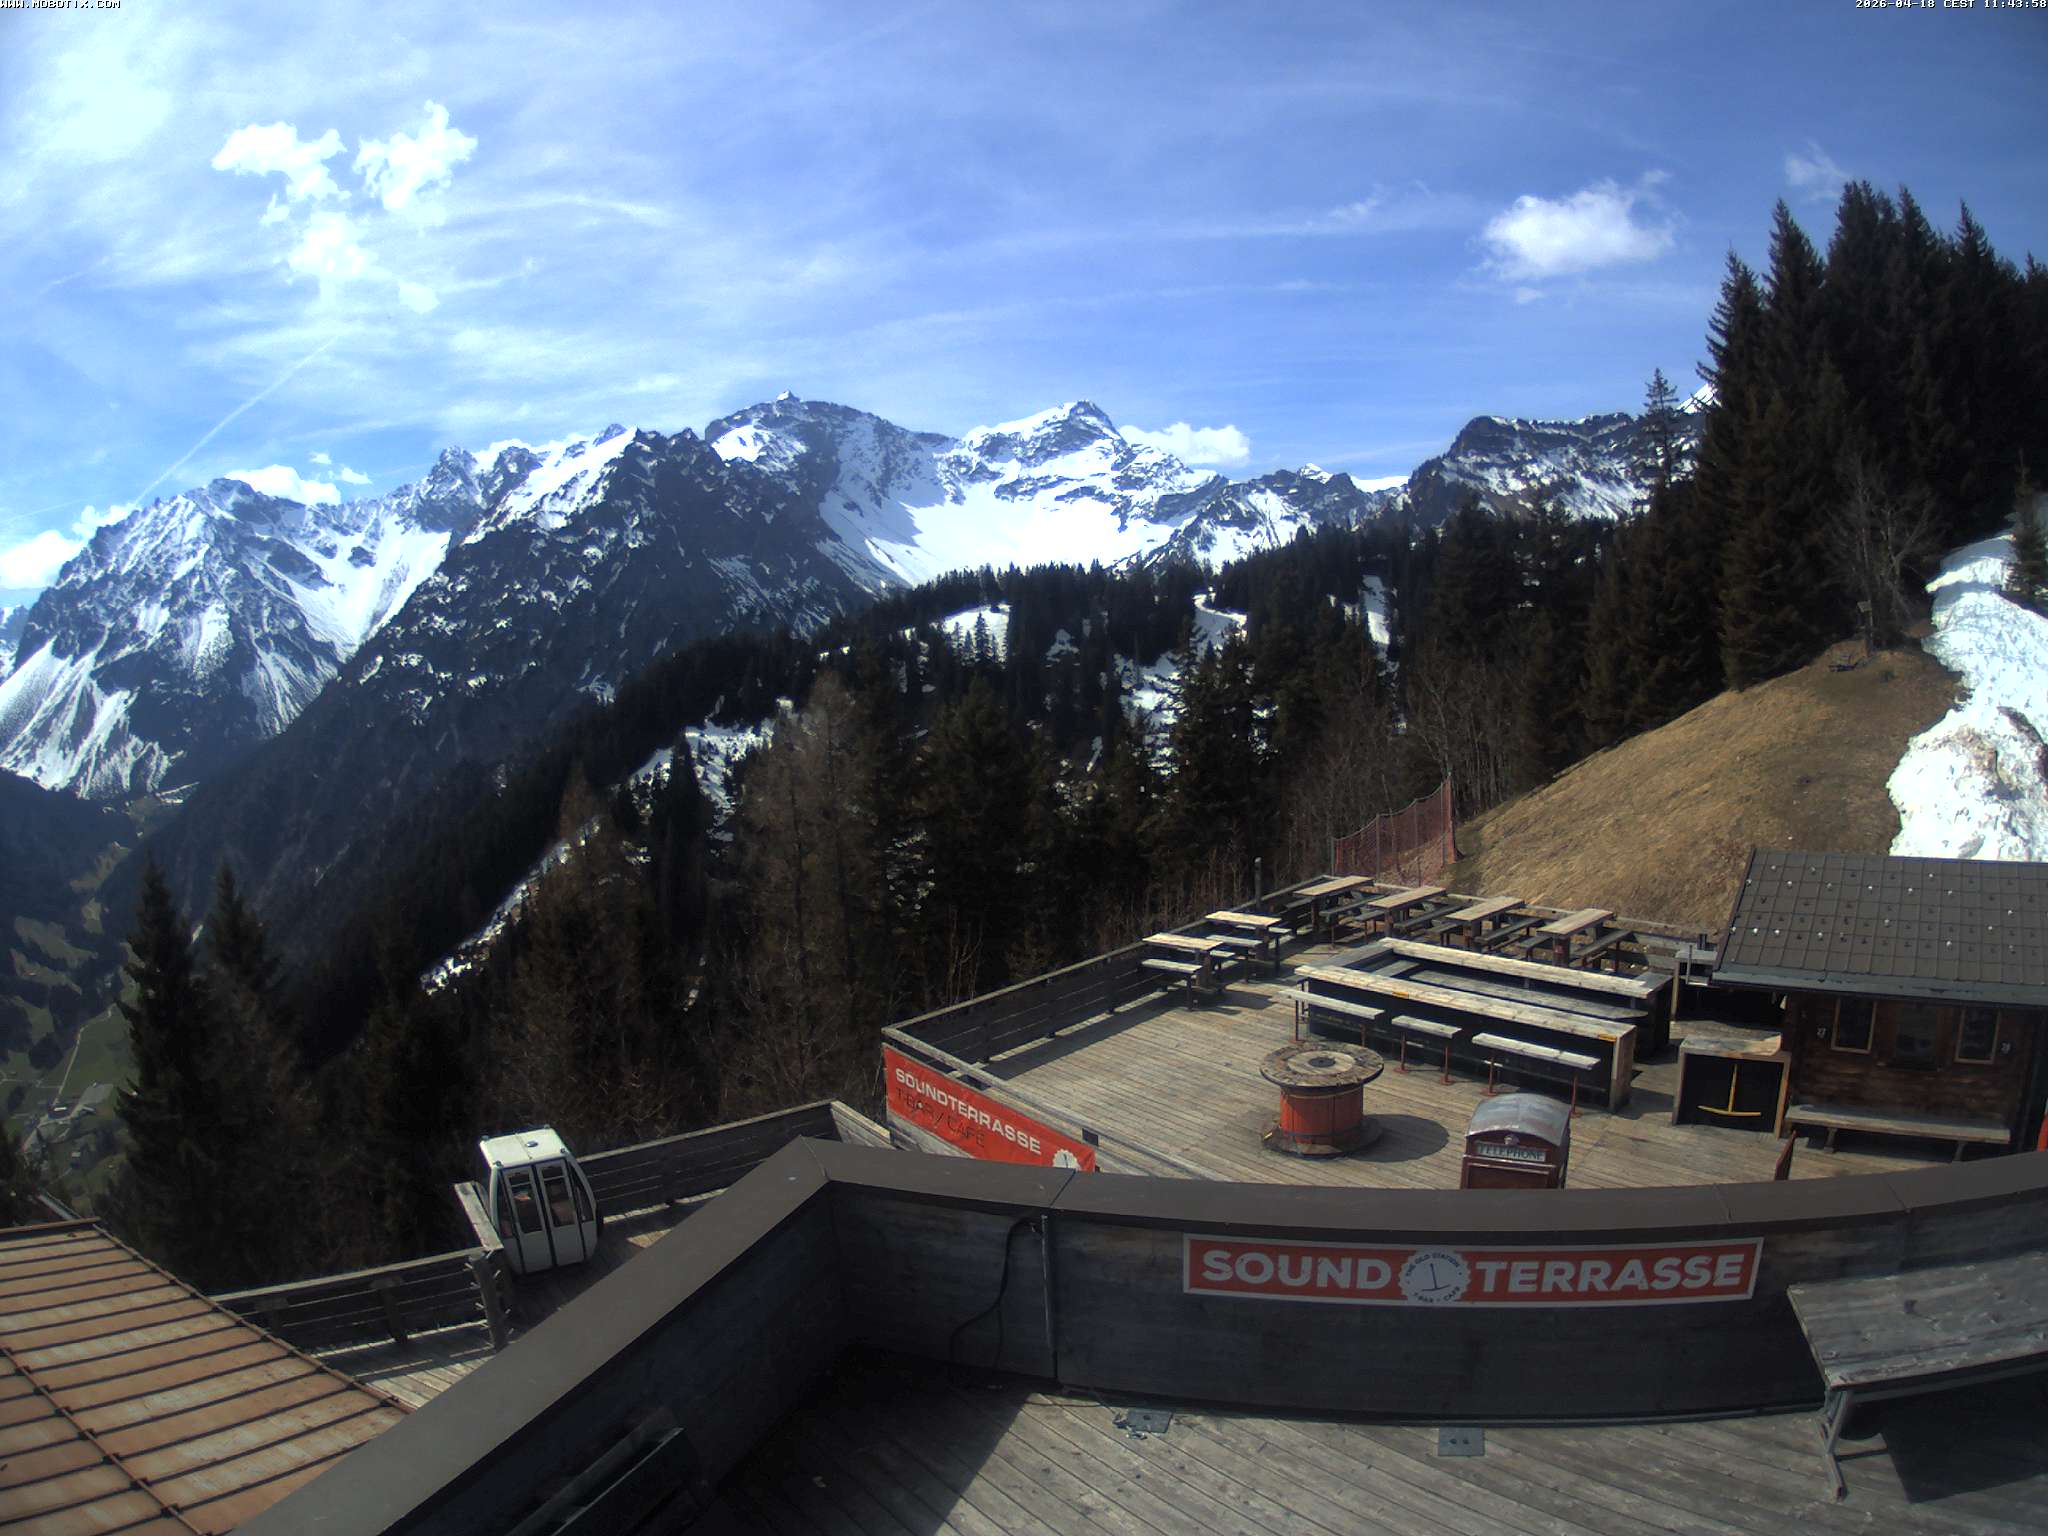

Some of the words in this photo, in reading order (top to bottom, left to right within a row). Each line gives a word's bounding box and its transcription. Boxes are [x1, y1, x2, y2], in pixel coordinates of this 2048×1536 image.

[895, 1067, 1042, 1156] SOUNDTERRASSE
[1478, 1143, 1543, 1160] TELEPHONE
[1202, 1250, 1392, 1289] SOUND
[1475, 1253, 1746, 1293] TERRASSE
